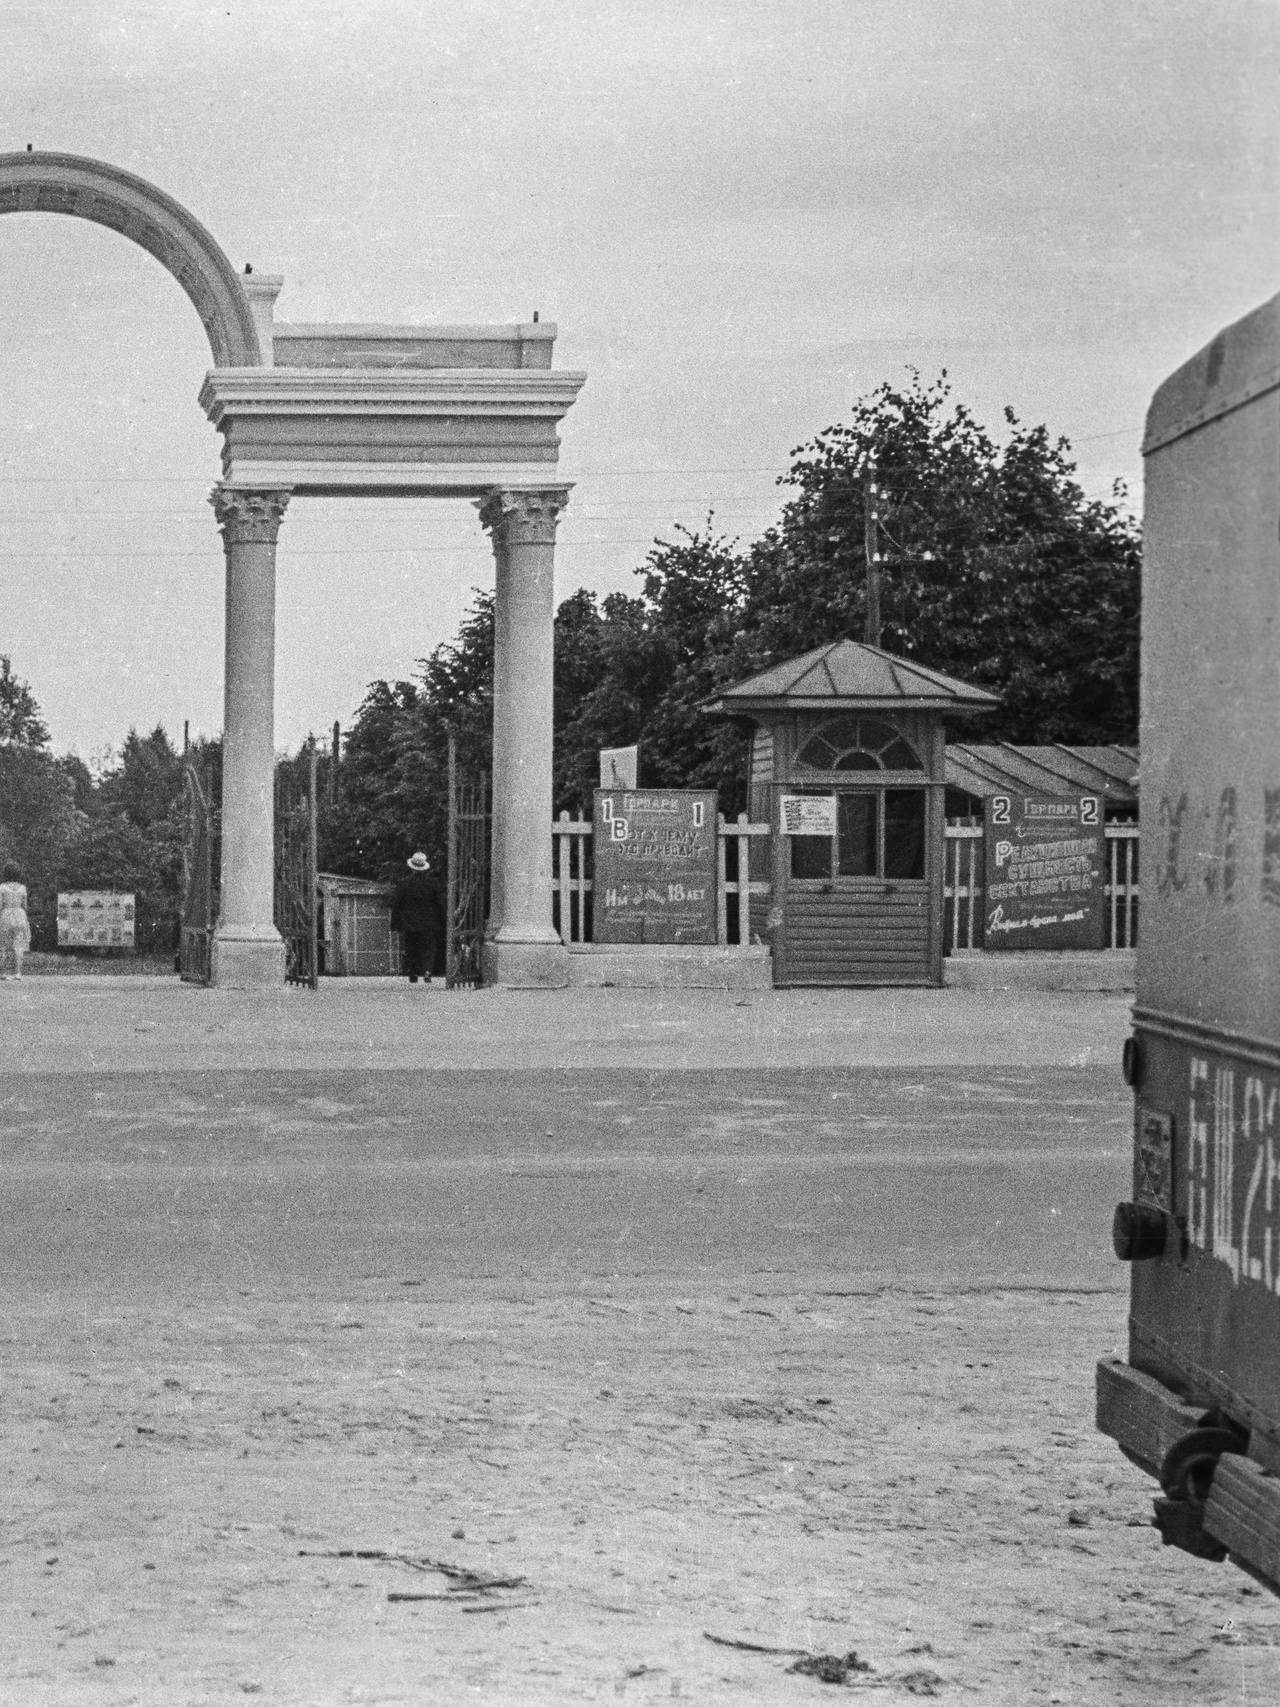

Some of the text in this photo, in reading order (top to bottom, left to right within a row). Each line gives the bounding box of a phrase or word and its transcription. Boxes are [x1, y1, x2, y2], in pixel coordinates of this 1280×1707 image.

[602, 797, 614, 824] 1
[992, 796, 1011, 824] 2
[1080, 797, 1098, 825] 2
[667, 884, 685, 903] 18
